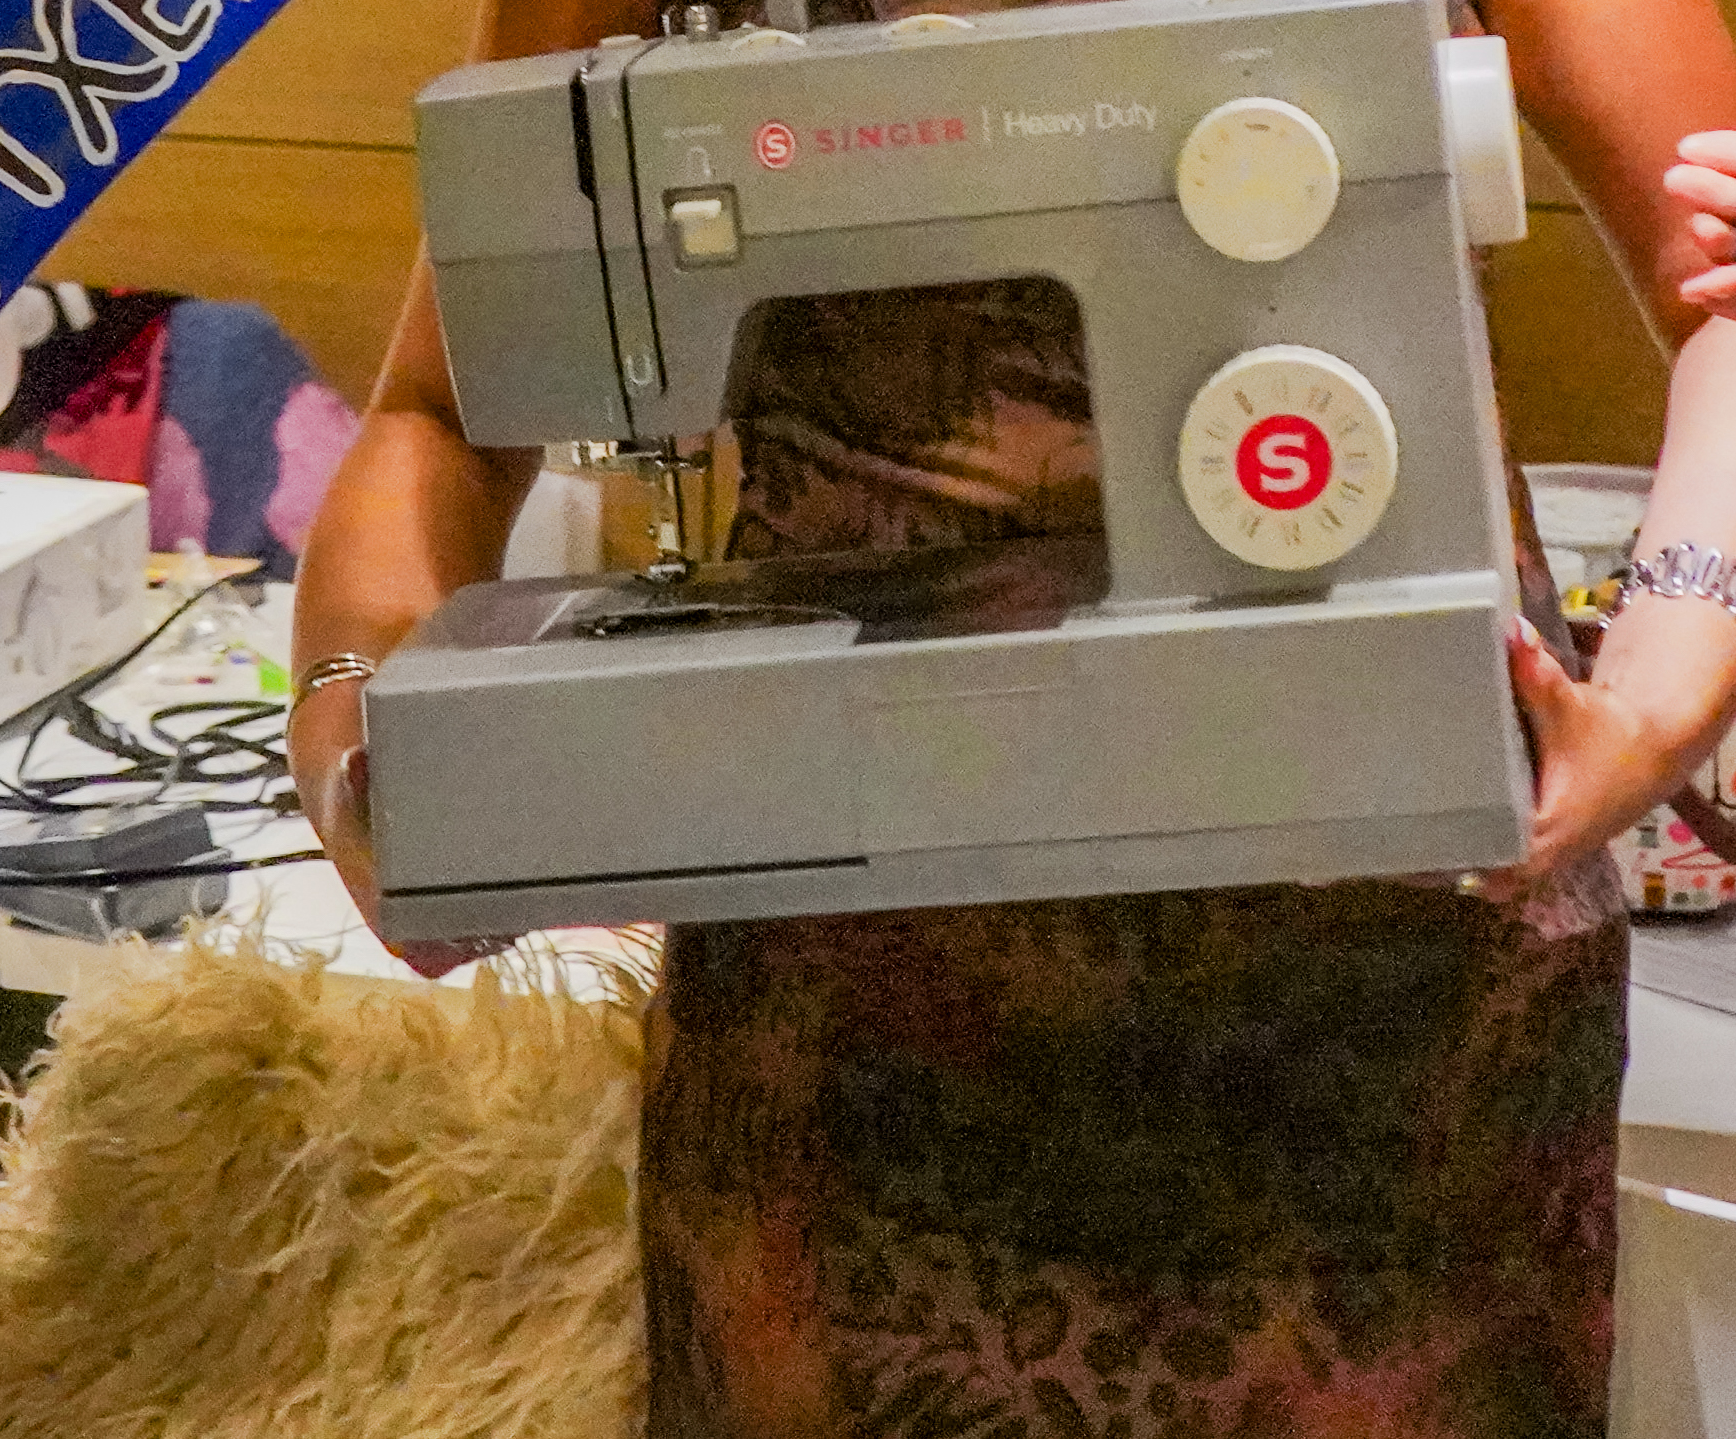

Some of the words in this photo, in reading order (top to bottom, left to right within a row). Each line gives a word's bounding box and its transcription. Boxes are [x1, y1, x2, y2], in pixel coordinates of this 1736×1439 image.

[815, 118, 965, 153] SINGER
[1004, 109, 1086, 139] Heavy
[1095, 102, 1158, 133] Duty
[1256, 433, 1311, 494] S
